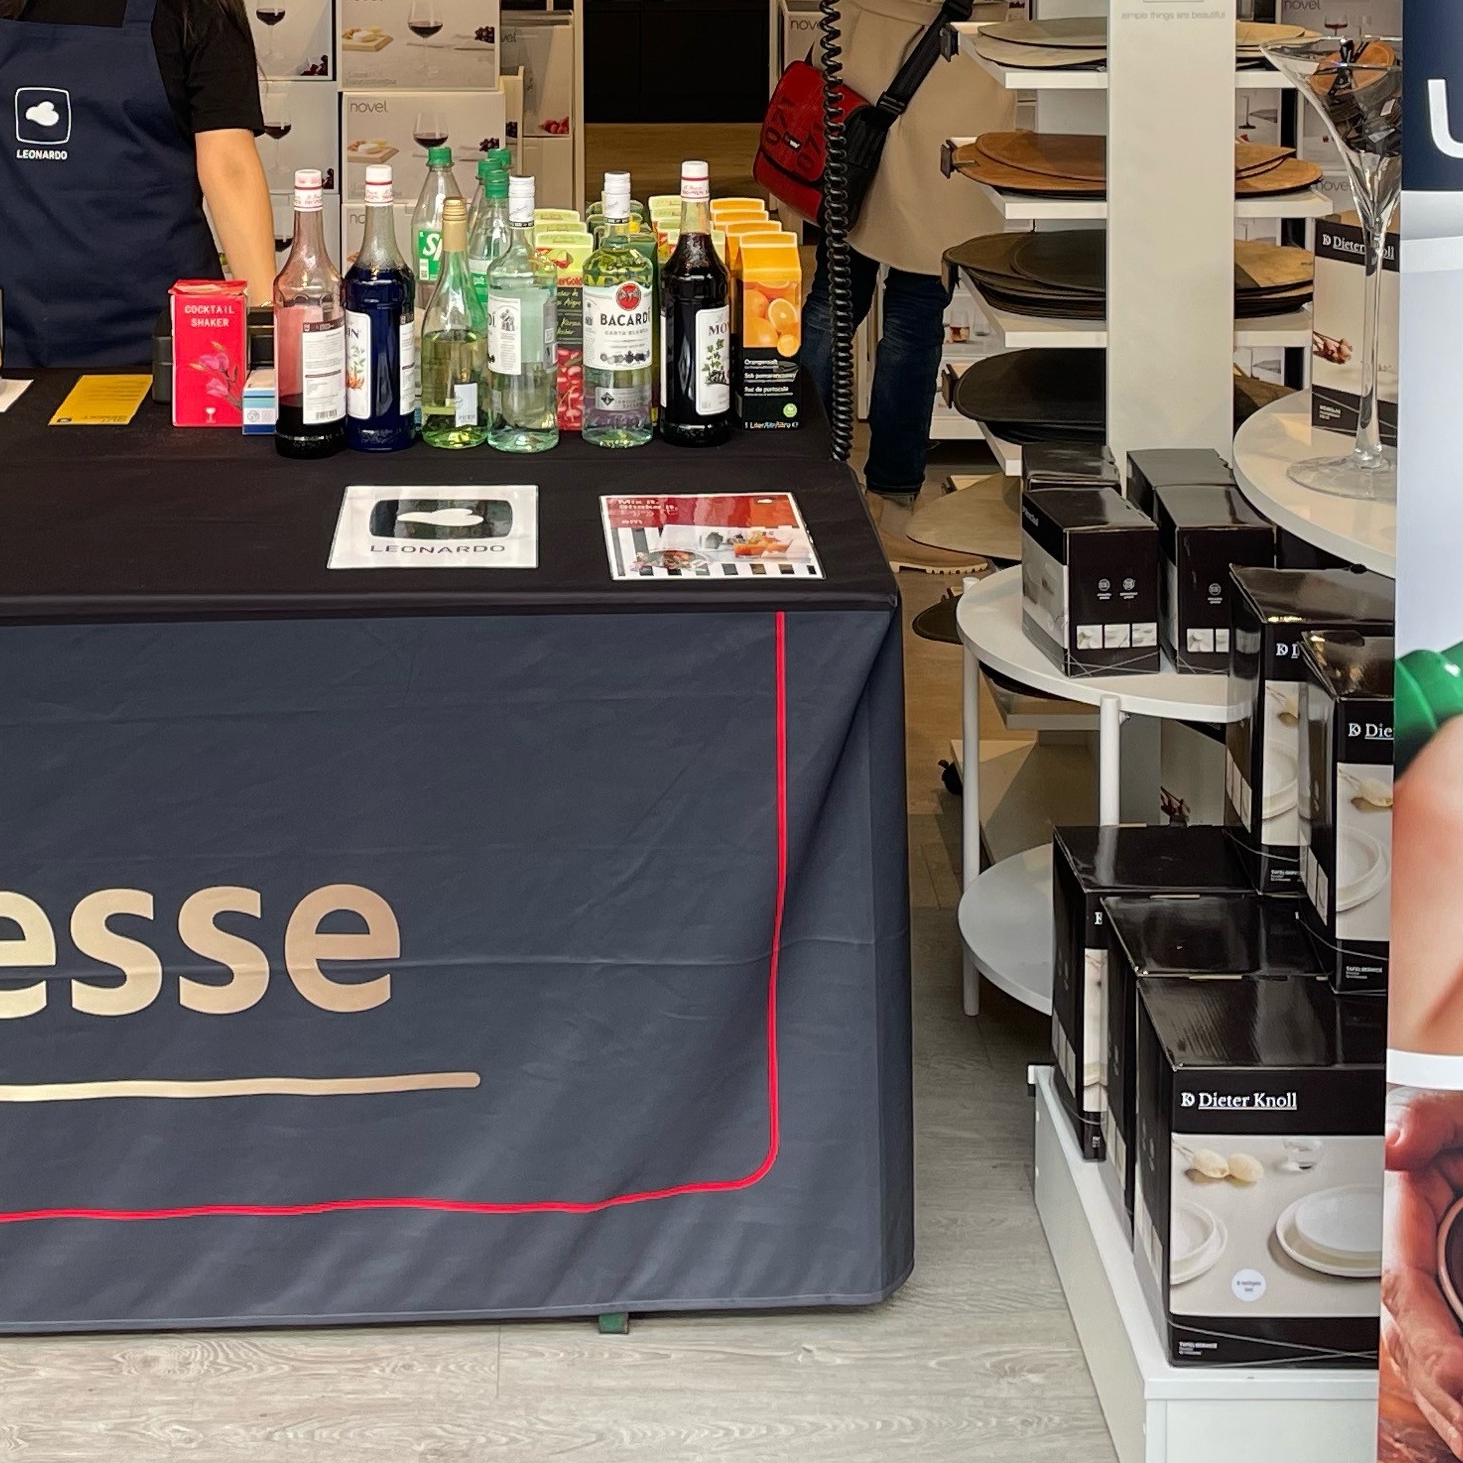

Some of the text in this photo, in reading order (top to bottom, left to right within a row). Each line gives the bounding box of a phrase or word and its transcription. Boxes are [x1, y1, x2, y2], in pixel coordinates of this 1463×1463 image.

[790, 19, 820, 31] nov
[349, 100, 388, 114] novel
[16, 148, 68, 161] LEONARDO
[1333, 235, 1365, 253] Dieter
[184, 304, 235, 315] COCKTAIL
[191, 317, 230, 328] SHAKER
[370, 544, 506, 554] LEONARDO
[1364, 723, 1394, 739] Die
[1197, 1091, 1298, 1108] Dieter Knoll
